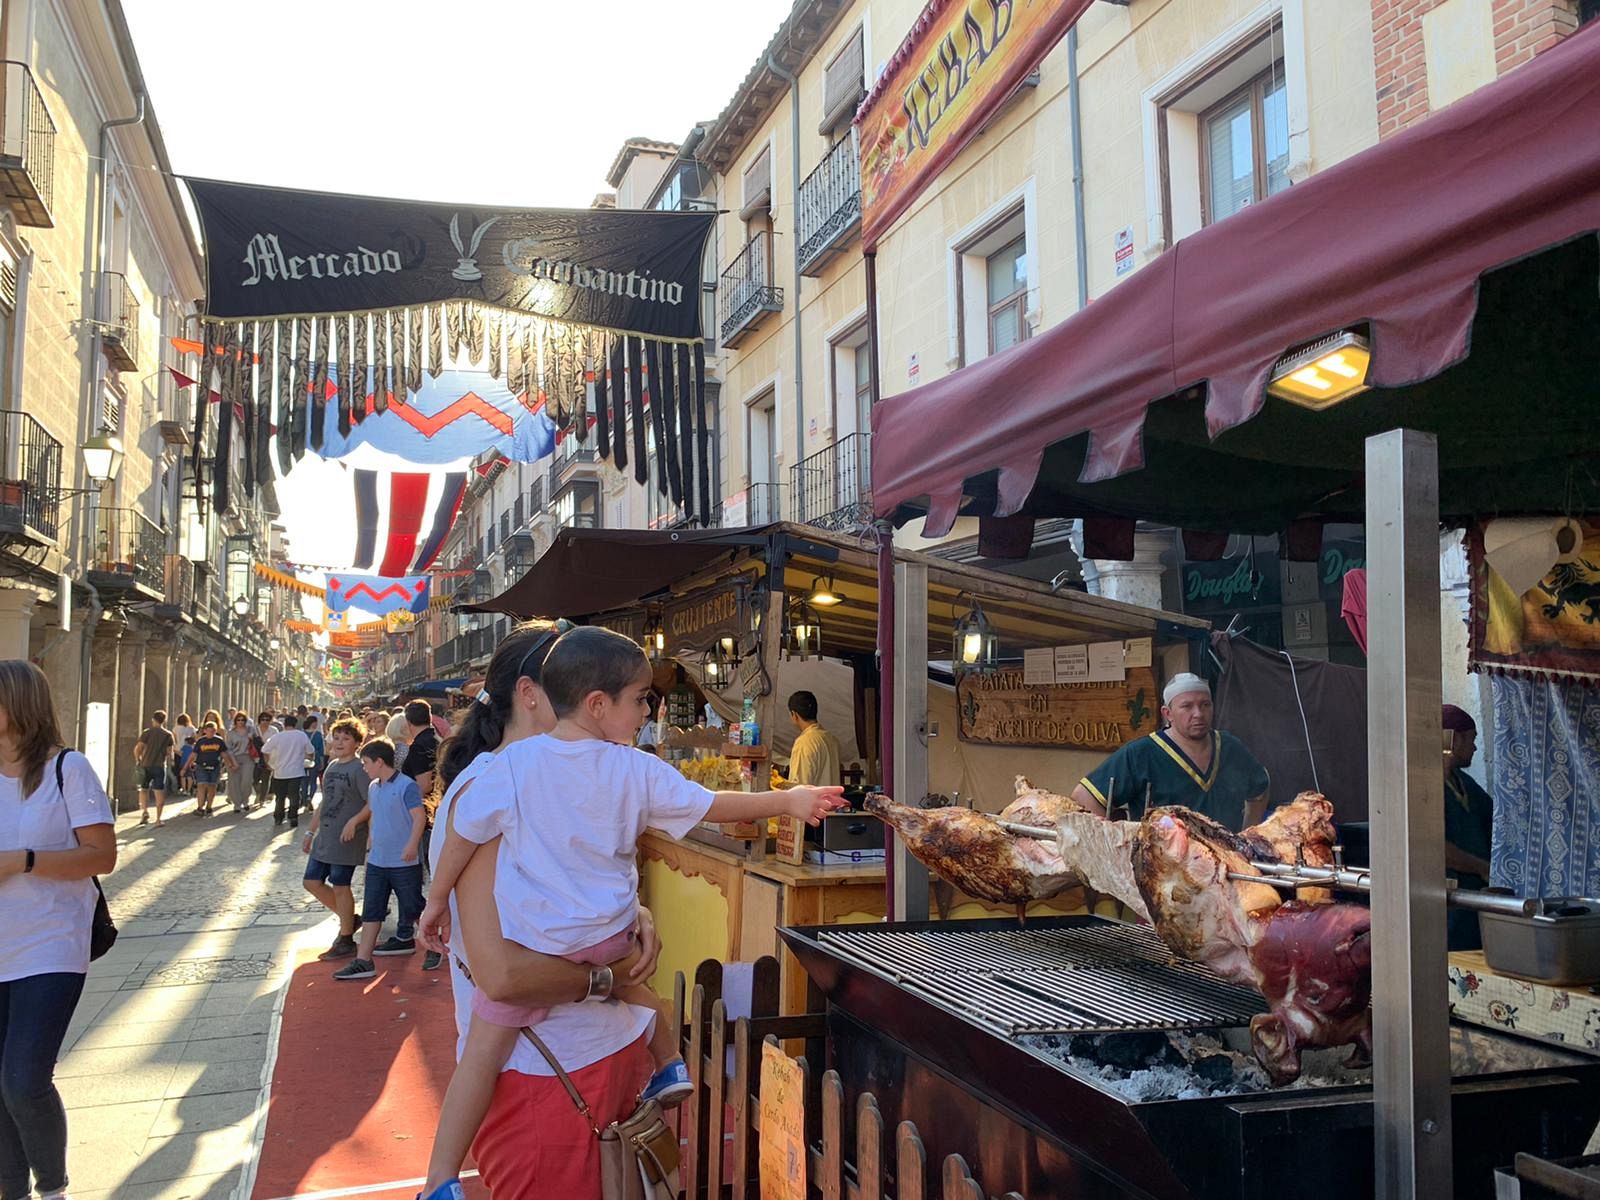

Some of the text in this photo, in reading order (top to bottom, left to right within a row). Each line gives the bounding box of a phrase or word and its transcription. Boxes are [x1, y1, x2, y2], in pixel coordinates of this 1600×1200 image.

[241, 232, 402, 286] Mercado
[1029, 694, 1050, 713] EN
[995, 719, 1122, 743] ACEITE DE OLIVA
